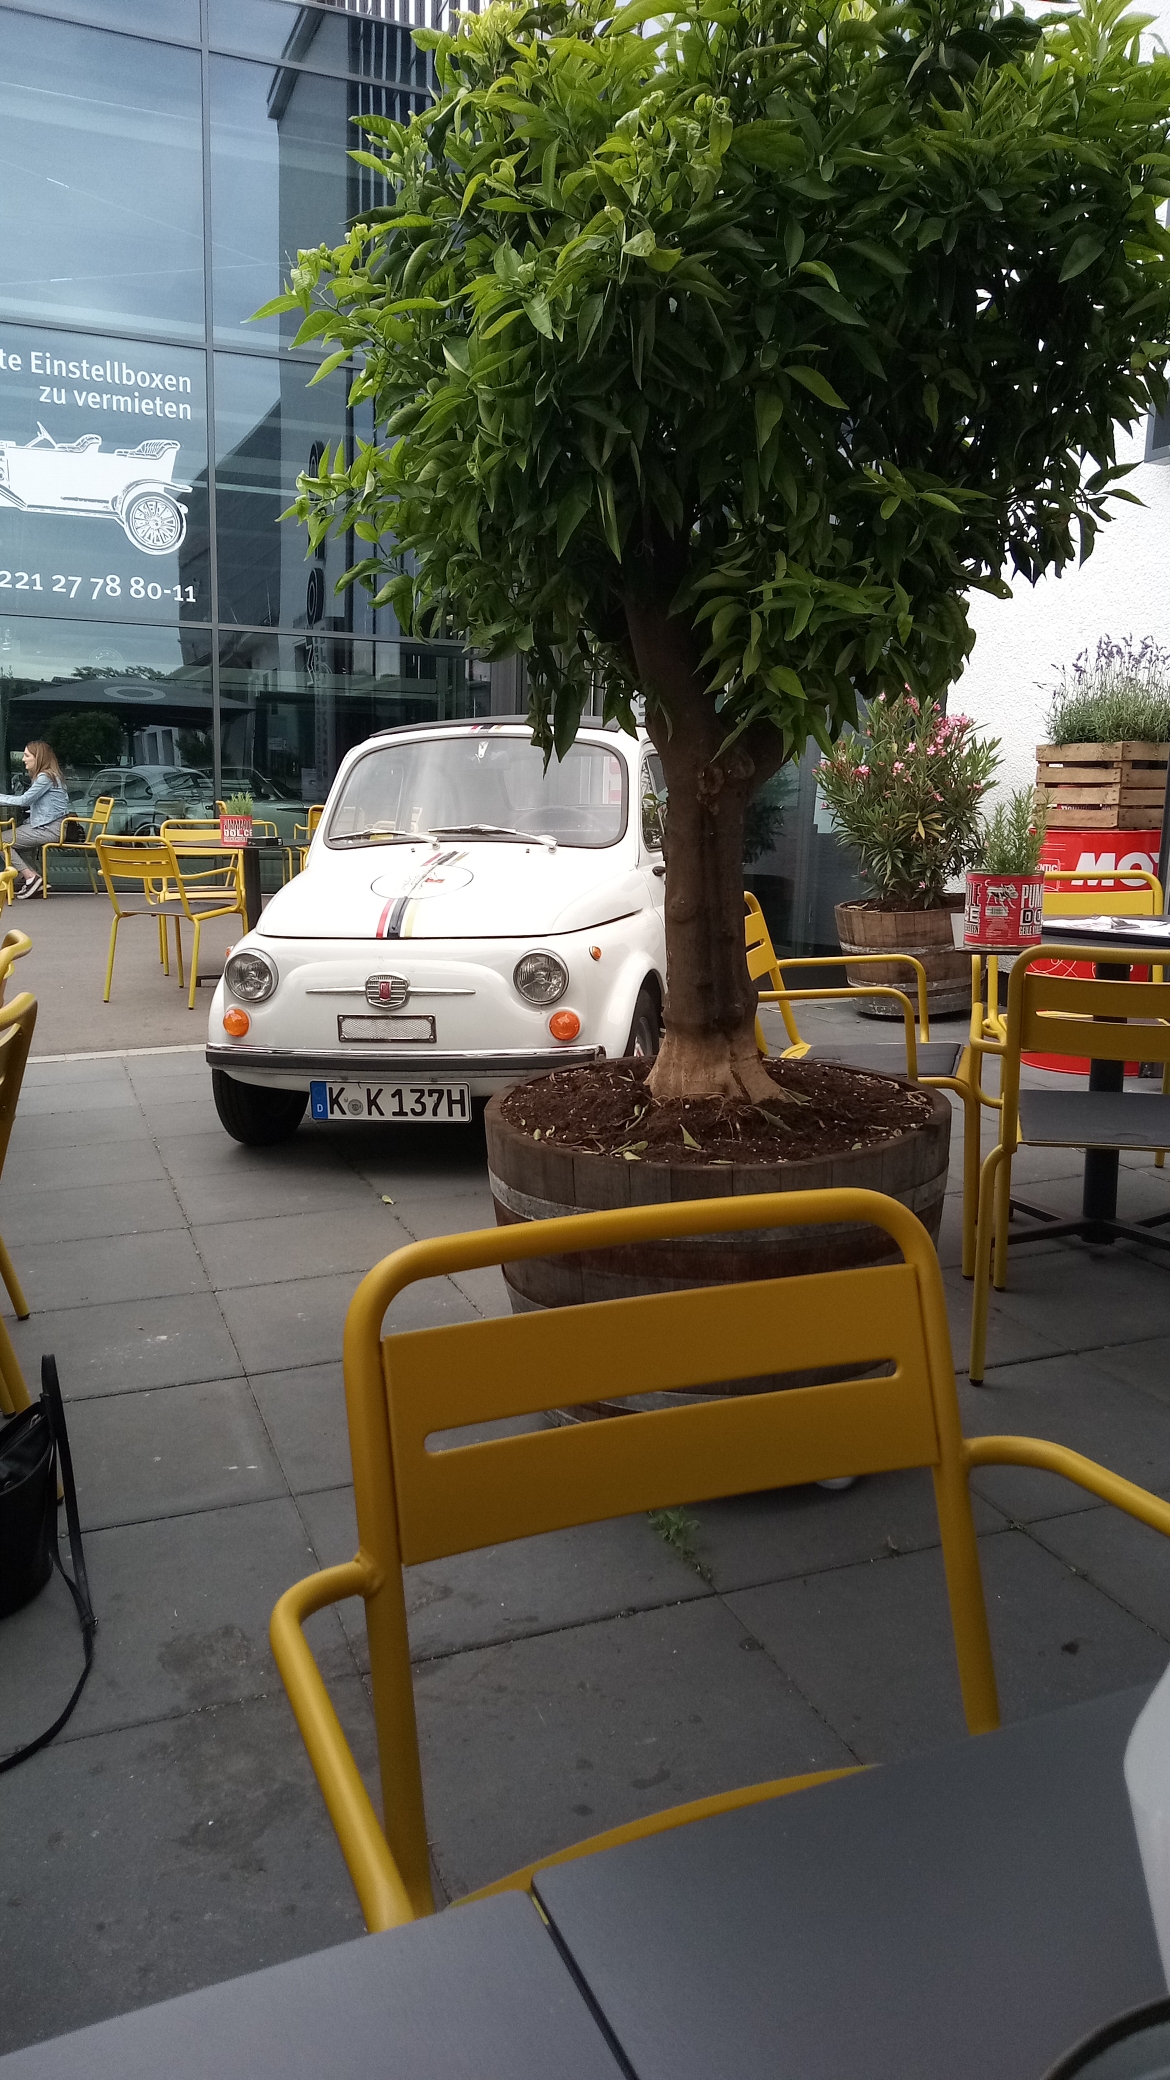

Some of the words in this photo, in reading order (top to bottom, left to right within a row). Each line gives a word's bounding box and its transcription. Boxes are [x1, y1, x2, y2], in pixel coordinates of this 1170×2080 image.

[0, 348, 22, 371] te
[30, 351, 191, 393] Einstellboxen
[39, 385, 66, 405] zu
[73, 389, 191, 420] vermieten
[0, 570, 43, 591] 221
[51, 574, 82, 599] 27
[90, 574, 121, 600] 78
[129, 576, 196, 602] 80-11
[1071, 852, 1159, 886] MO
